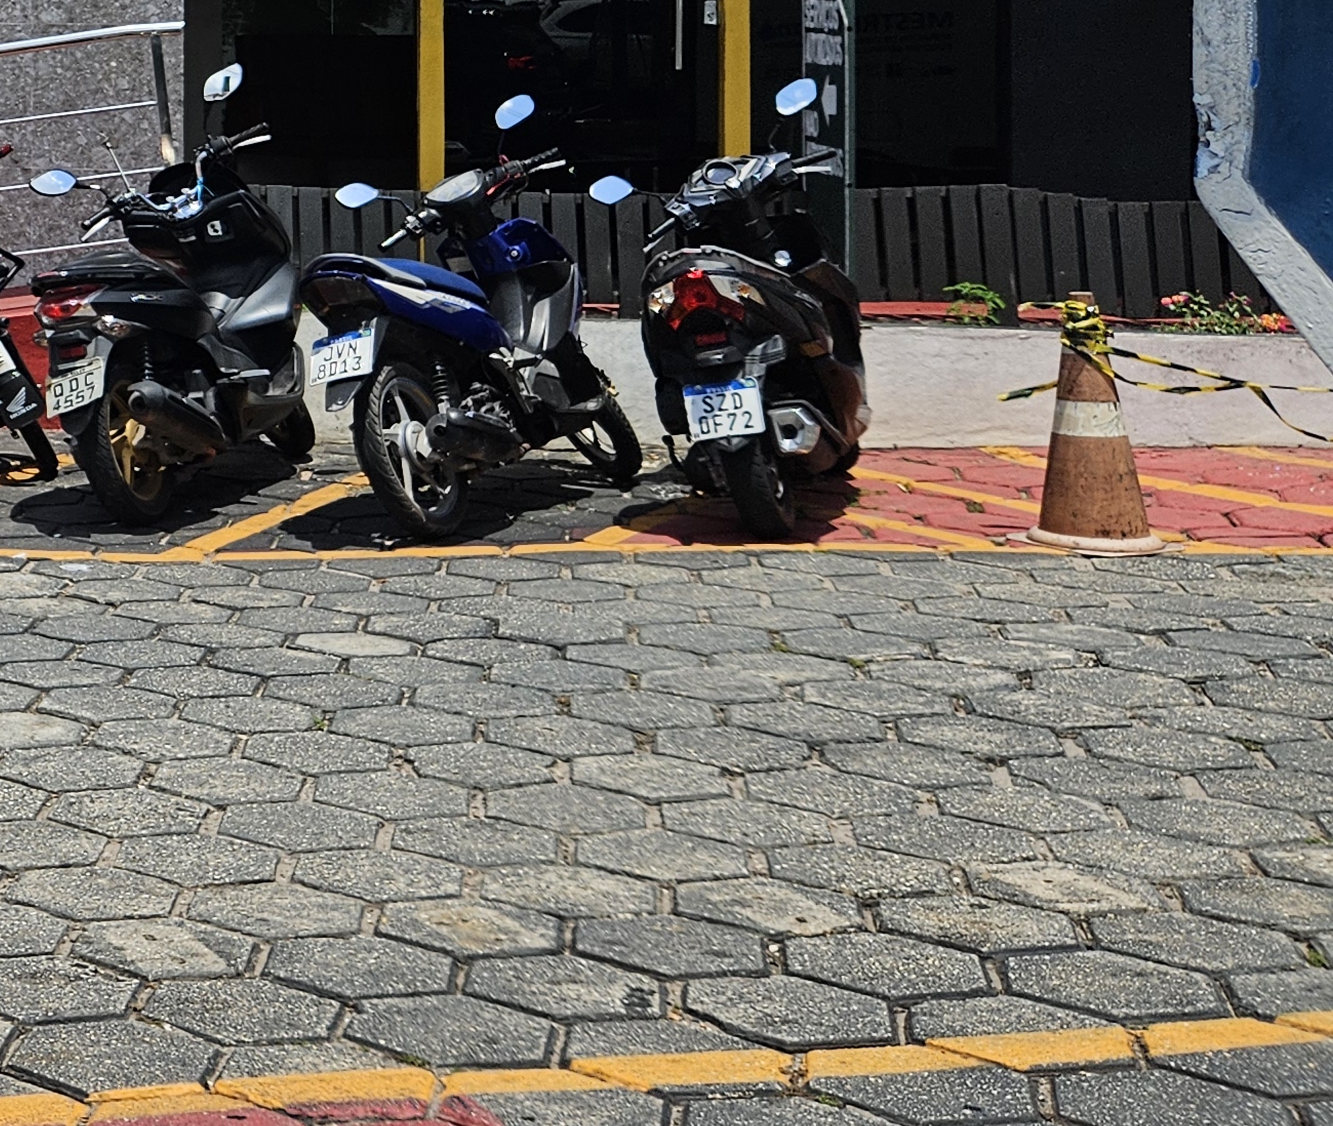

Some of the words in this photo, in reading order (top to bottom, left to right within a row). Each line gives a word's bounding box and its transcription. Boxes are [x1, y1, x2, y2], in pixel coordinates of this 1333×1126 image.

[323, 340, 358, 362] JVN
[317, 355, 362, 380] 8D13
[52, 384, 96, 410] 4557
[701, 392, 743, 414] SZD
